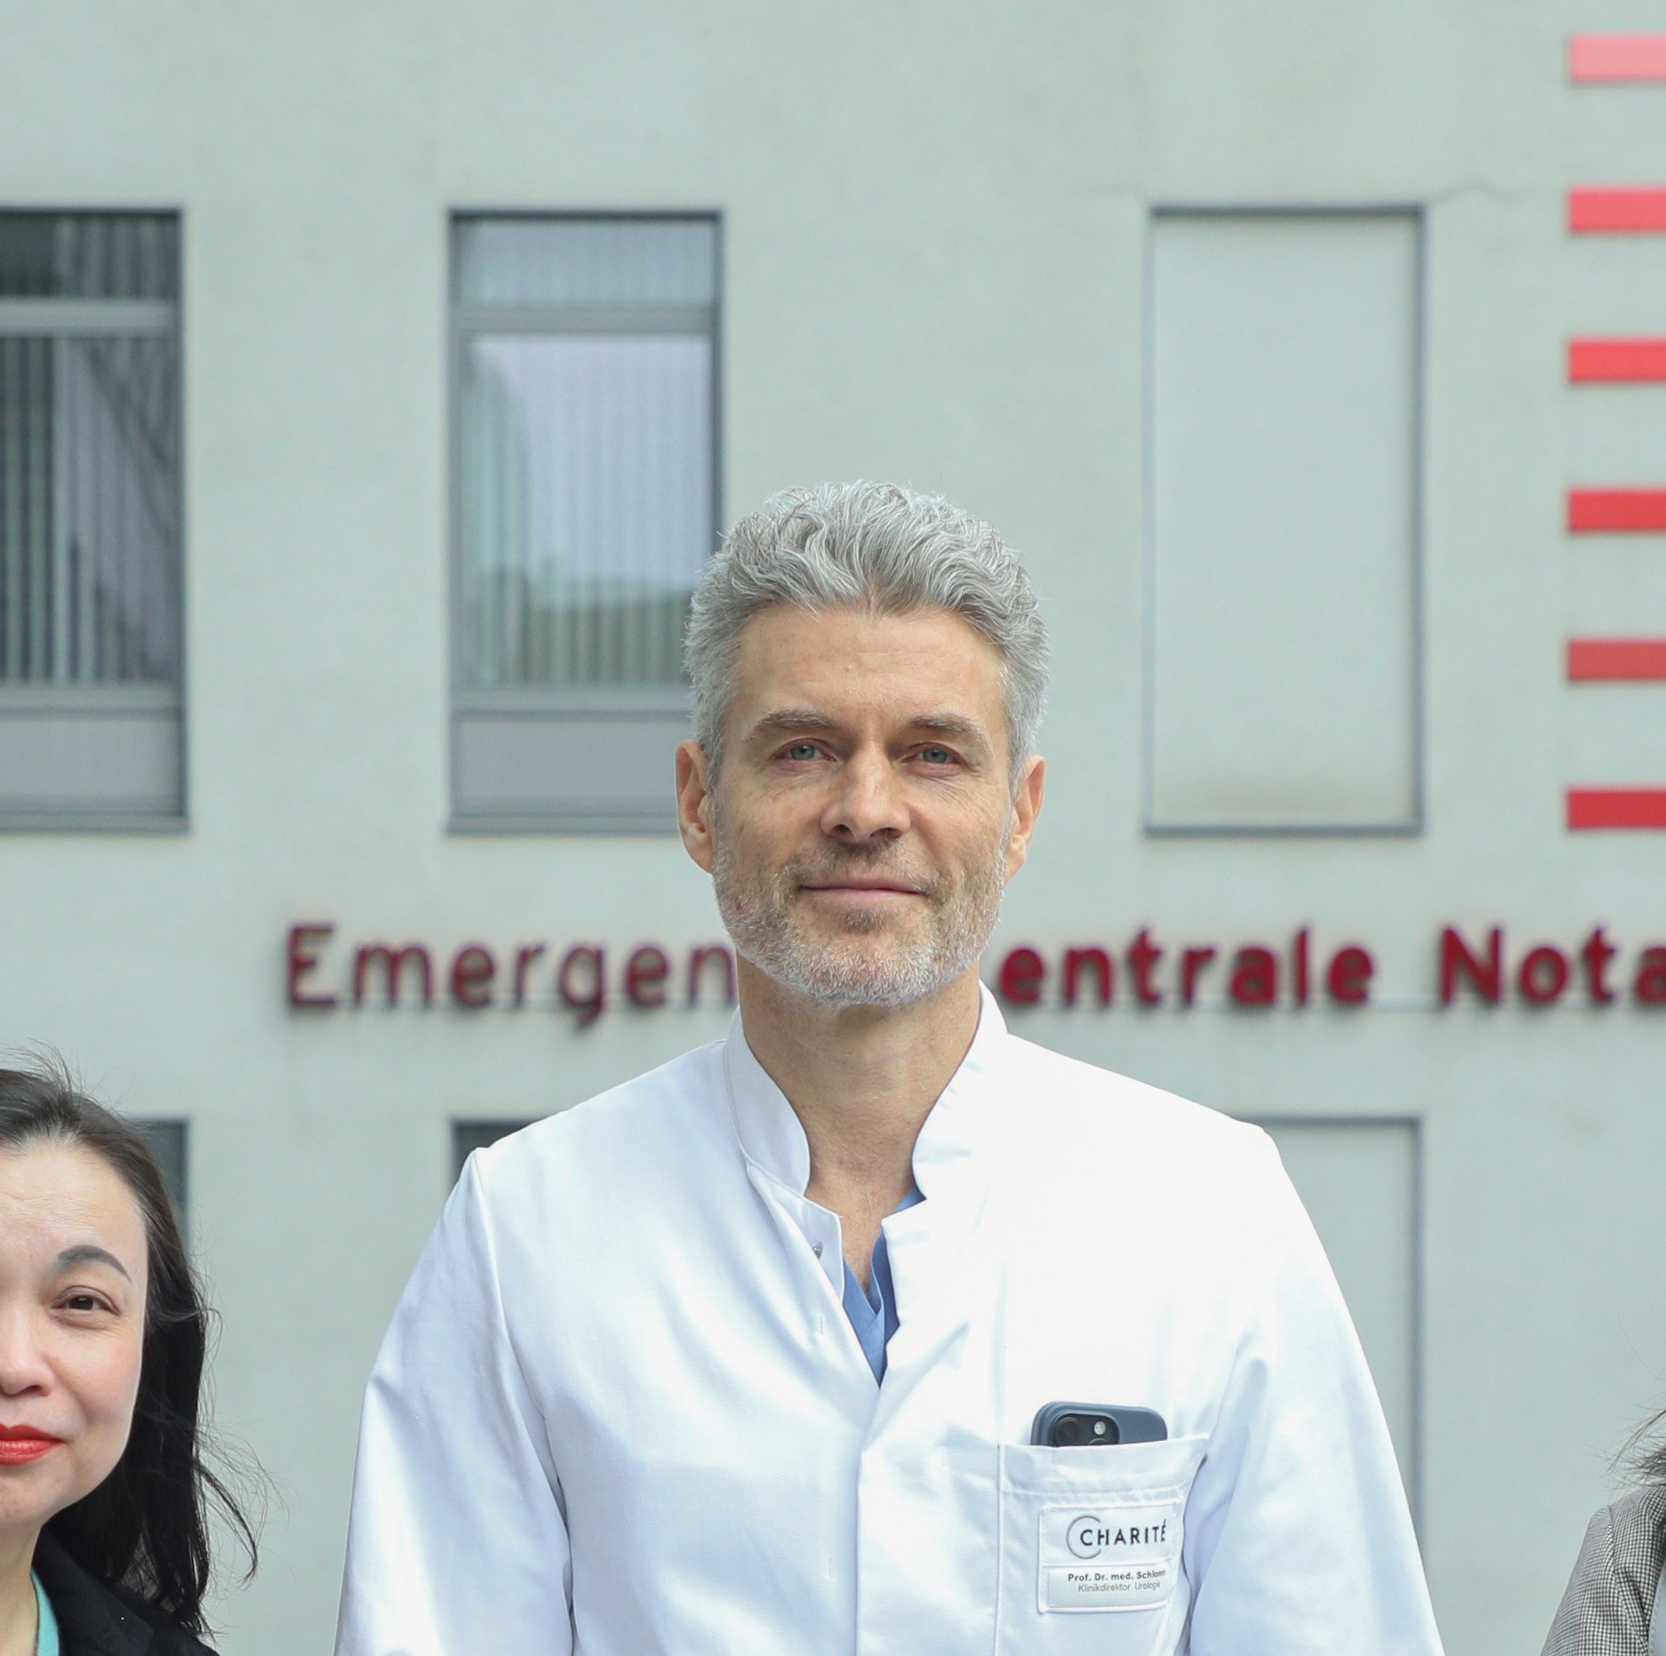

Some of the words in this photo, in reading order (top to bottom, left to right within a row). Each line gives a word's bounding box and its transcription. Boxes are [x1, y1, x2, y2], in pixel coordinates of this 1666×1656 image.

[288, 922, 737, 1029] Emergen
[997, 923, 1374, 1007] entrale
[1079, 1518, 1167, 1547] CHARITÉ
[1067, 1572, 1092, 1582] Prof.
[1094, 1572, 1109, 1581] Dr.
[1110, 1571, 1134, 1581] med.
[1077, 1582, 1131, 1593] Klinikdirektor
